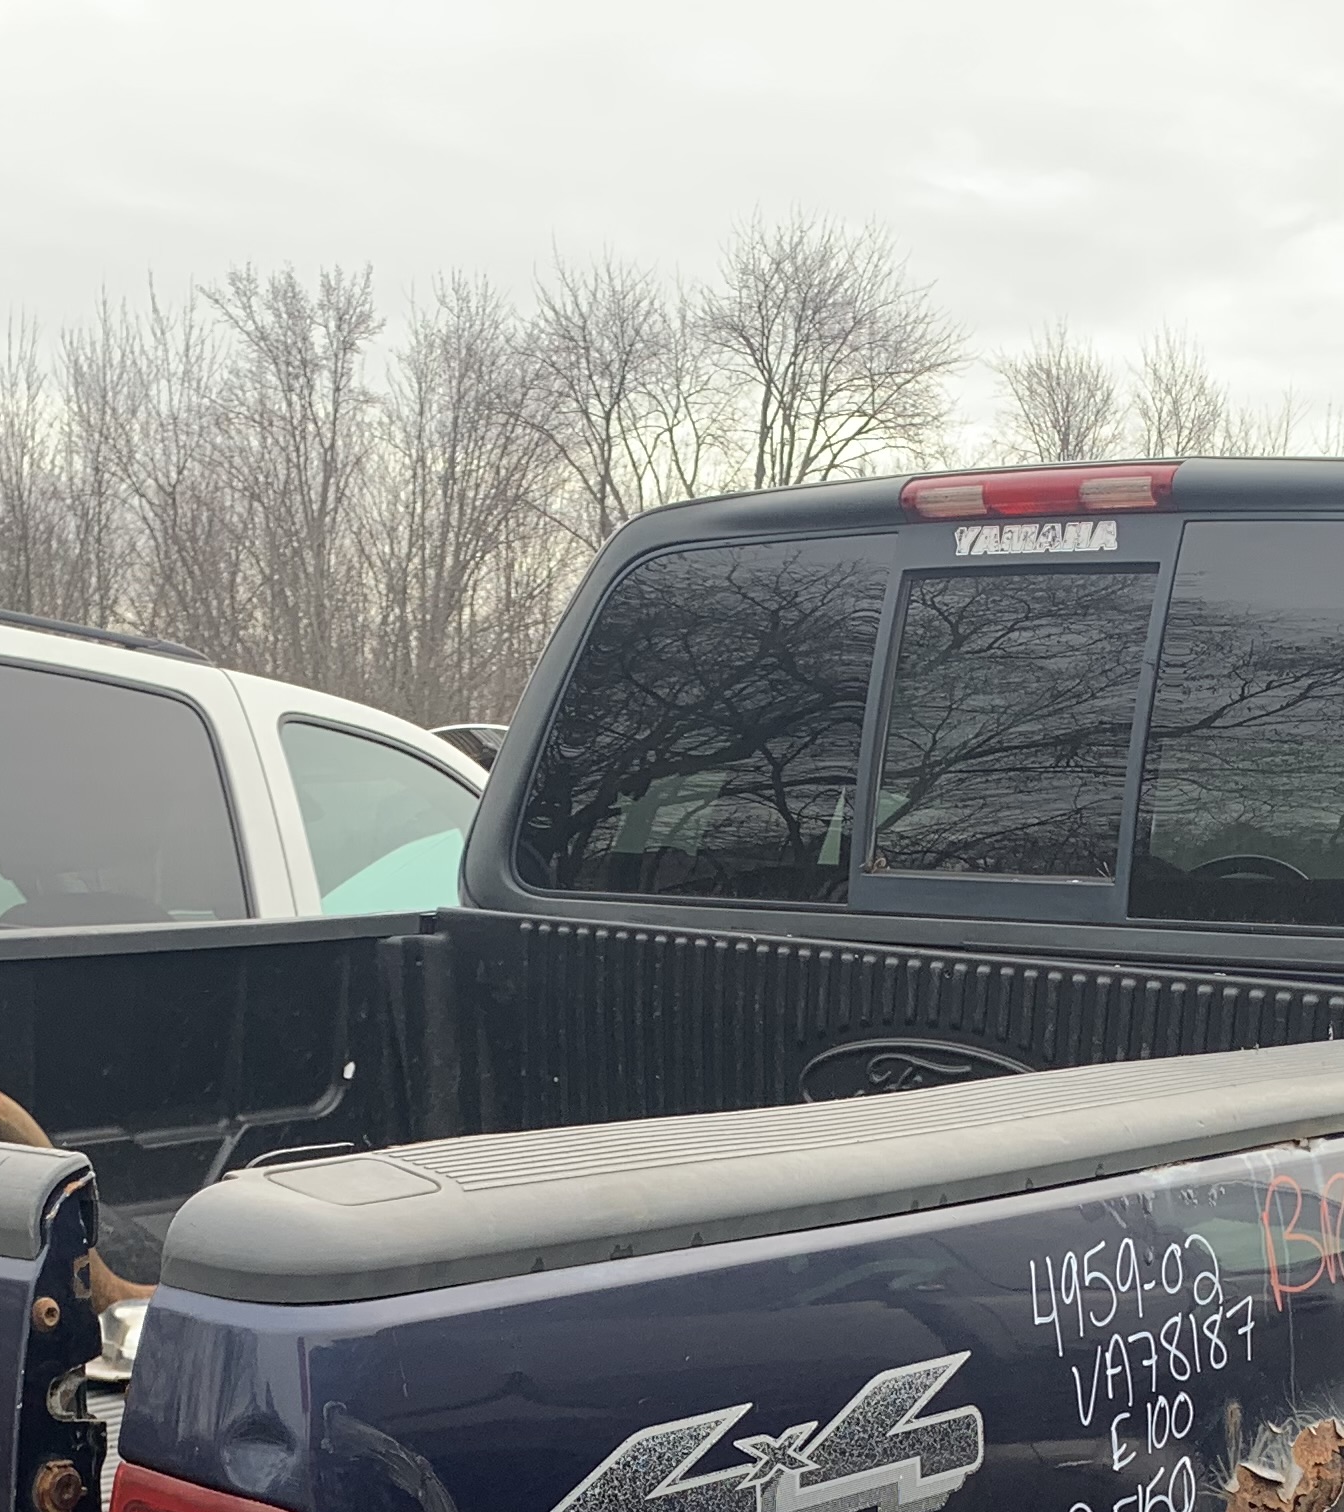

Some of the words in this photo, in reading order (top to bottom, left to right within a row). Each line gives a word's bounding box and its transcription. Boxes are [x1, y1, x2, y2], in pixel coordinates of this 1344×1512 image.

[954, 521, 1118, 556] YAMAHA
[1029, 1234, 1224, 1358] 4959-02
[1071, 1296, 1256, 1427] VA78187
